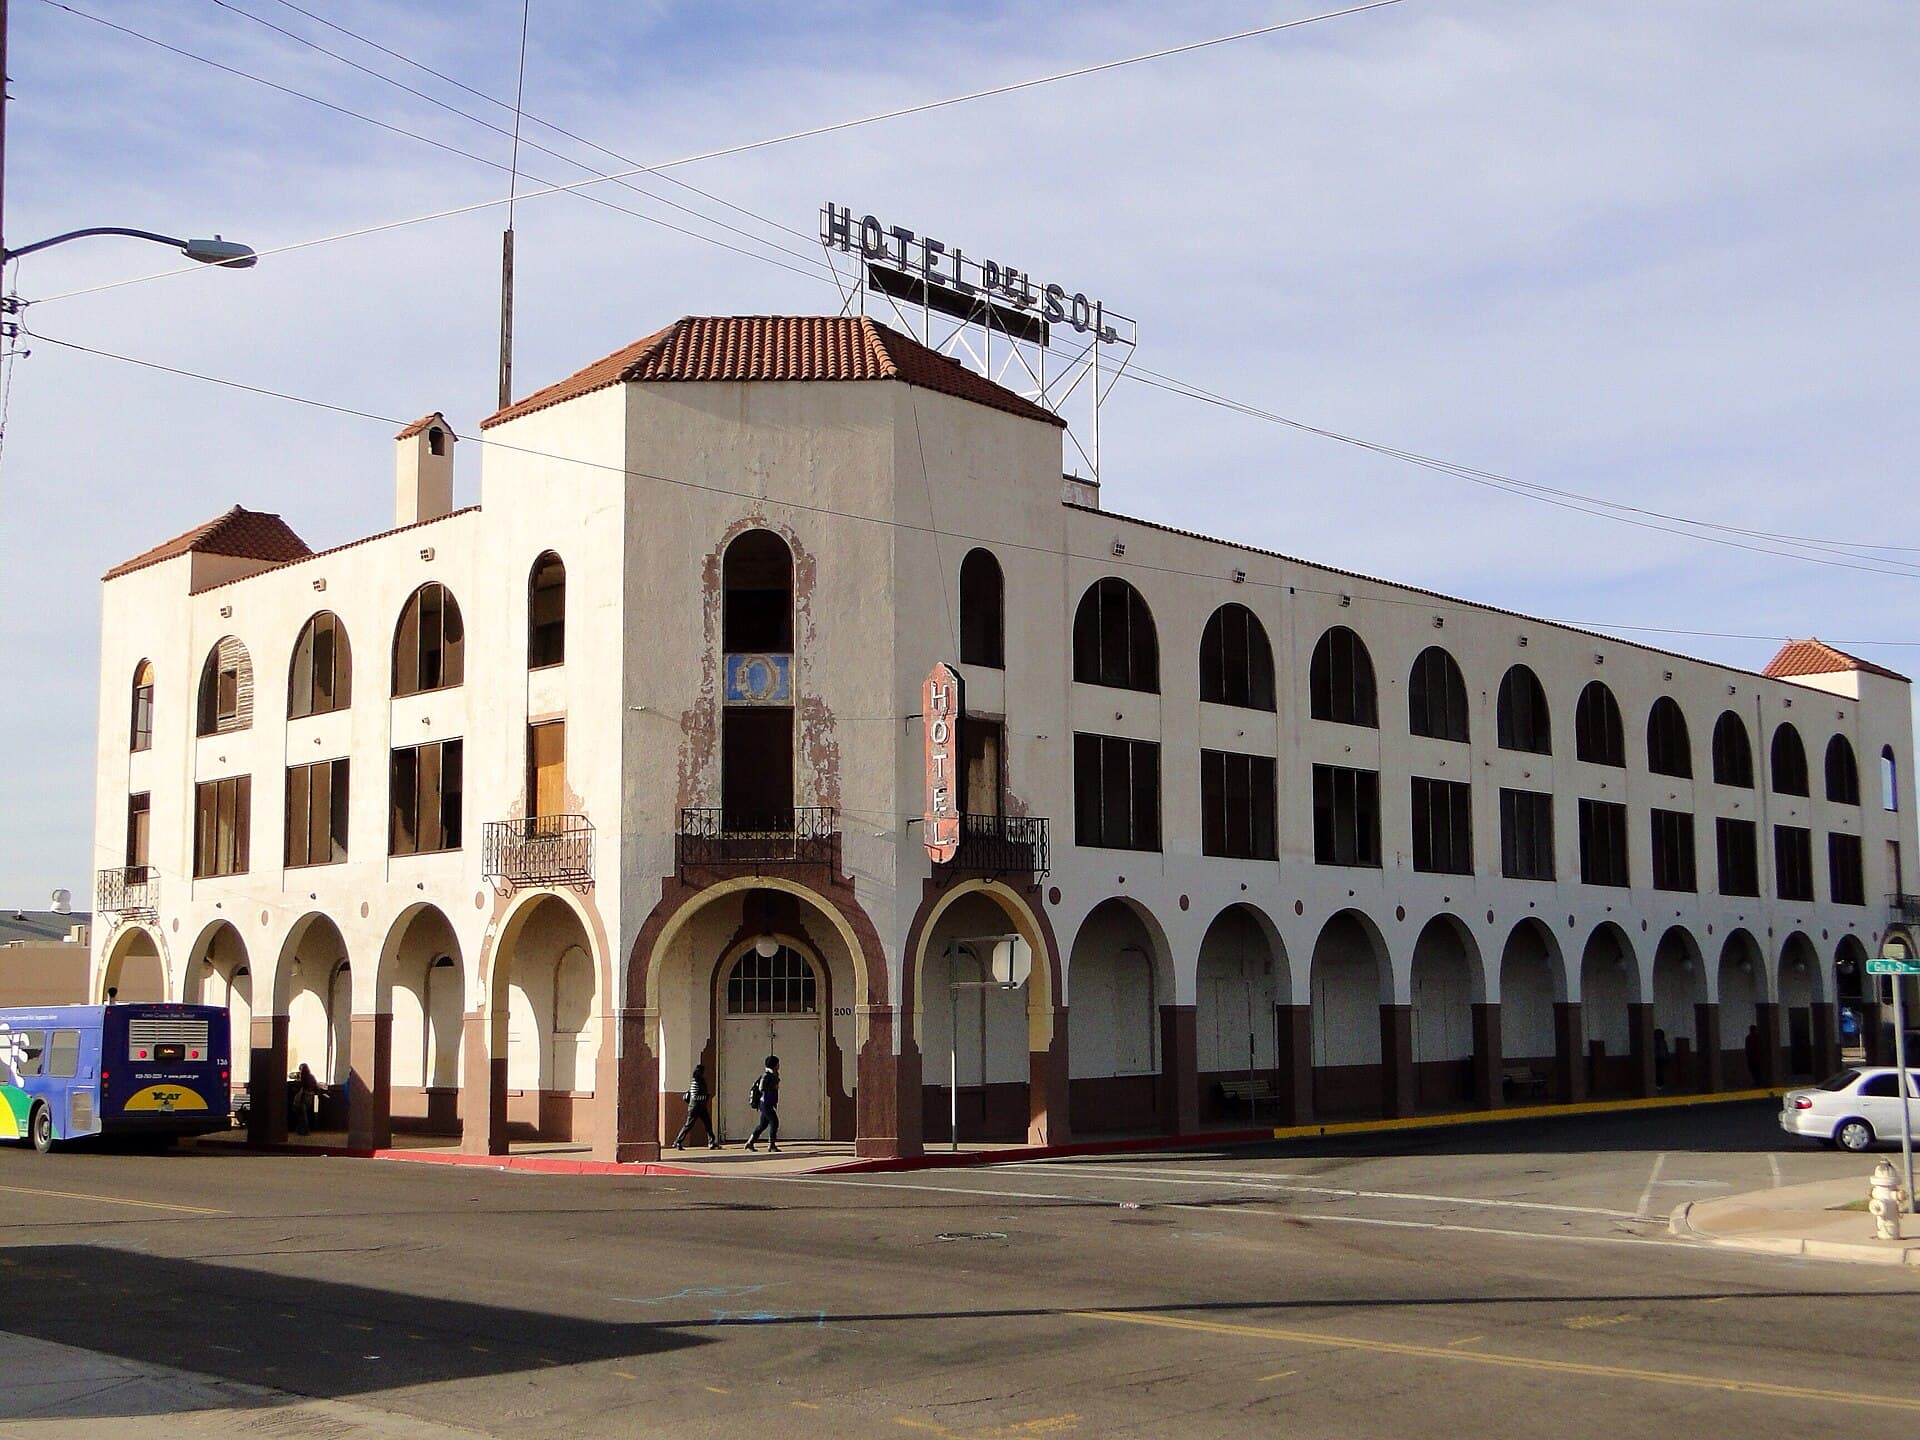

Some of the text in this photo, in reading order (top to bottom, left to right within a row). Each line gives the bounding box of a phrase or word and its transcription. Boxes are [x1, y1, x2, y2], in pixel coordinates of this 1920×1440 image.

[824, 201, 1118, 343] HOTEL DEL SOL
[930, 681, 949, 845] HOTEL
[834, 1007, 851, 1016] 200
